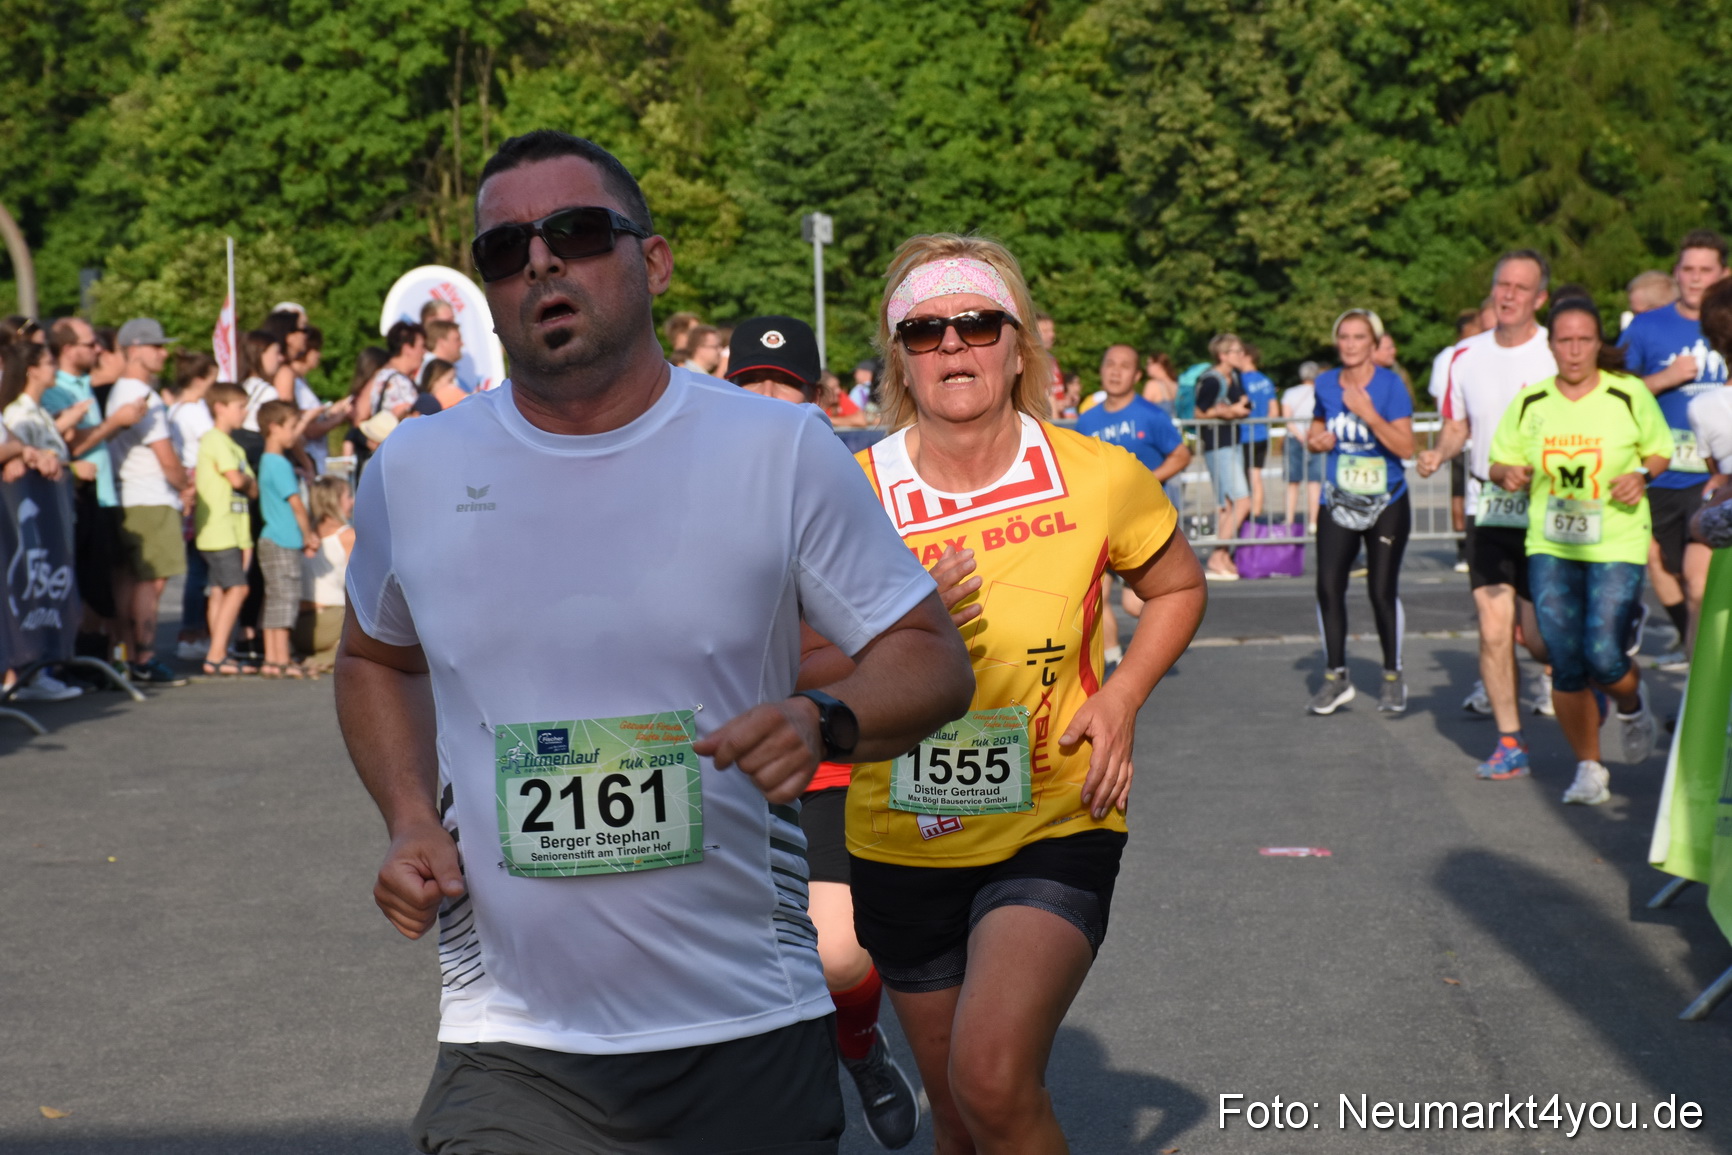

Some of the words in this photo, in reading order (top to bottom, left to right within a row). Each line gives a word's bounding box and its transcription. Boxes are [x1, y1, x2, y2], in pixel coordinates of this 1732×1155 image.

[1545, 434, 1602, 447] Müller
[1343, 470, 1380, 484] 1713
[456, 502, 496, 512] erima
[1486, 497, 1527, 515] 1790
[981, 511, 1077, 551] BÖGL
[1554, 514, 1588, 533] 673
[993, 735, 1019, 746] 2019
[525, 748, 600, 767] firmenlauf
[649, 752, 685, 767] 2019
[907, 744, 1010, 785] 1555
[915, 784, 947, 795] Distler
[951, 786, 1000, 796] Gertraud
[519, 769, 666, 833] 2161
[908, 794, 920, 802] Max
[923, 795, 938, 805] Bögl
[941, 797, 982, 805] Bauservice
[540, 835, 591, 850] Berger
[596, 830, 660, 845] Stephan
[531, 850, 595, 861] Seniorenstift
[598, 850, 613, 858] am
[616, 845, 651, 856] Tiroler
[653, 842, 671, 852] Hof
